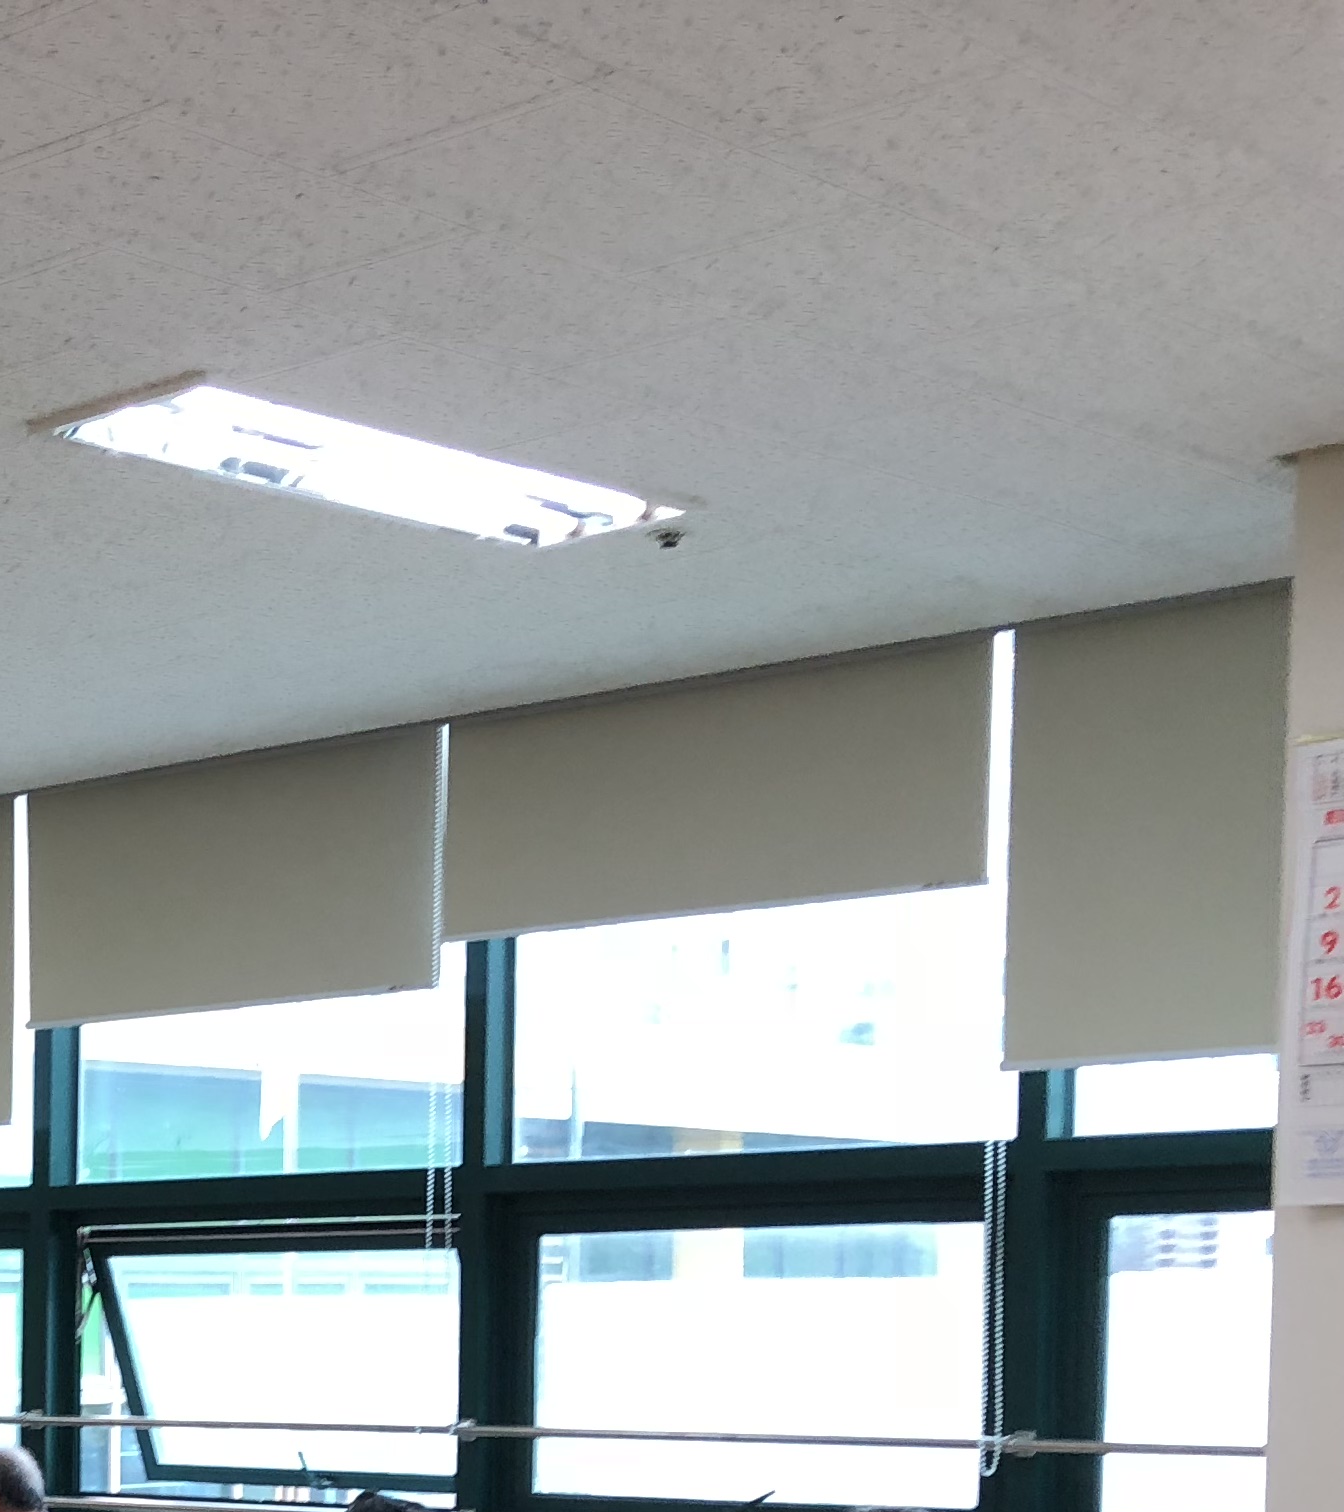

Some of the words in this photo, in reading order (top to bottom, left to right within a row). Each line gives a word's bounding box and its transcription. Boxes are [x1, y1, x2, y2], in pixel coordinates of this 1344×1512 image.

[1323, 886, 1341, 909] 2
[1320, 930, 1339, 954] 9
[1311, 975, 1343, 1000] 16
